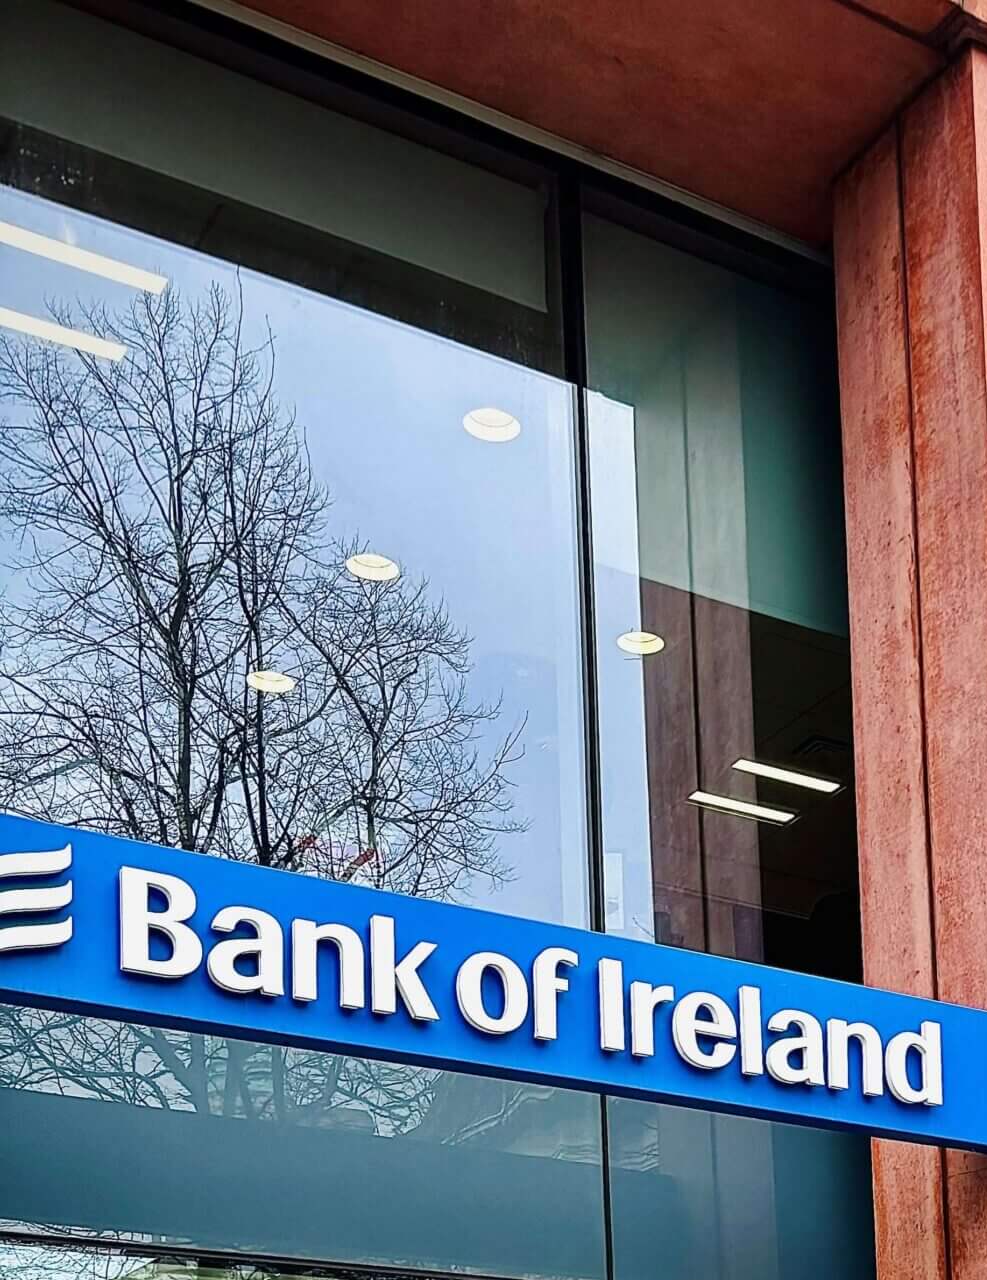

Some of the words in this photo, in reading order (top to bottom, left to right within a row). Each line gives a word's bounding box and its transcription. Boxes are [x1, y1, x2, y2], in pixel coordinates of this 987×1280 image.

[119, 866, 440, 1021] Bank
[456, 947, 578, 1041] of
[597, 957, 943, 1107] Ireland
